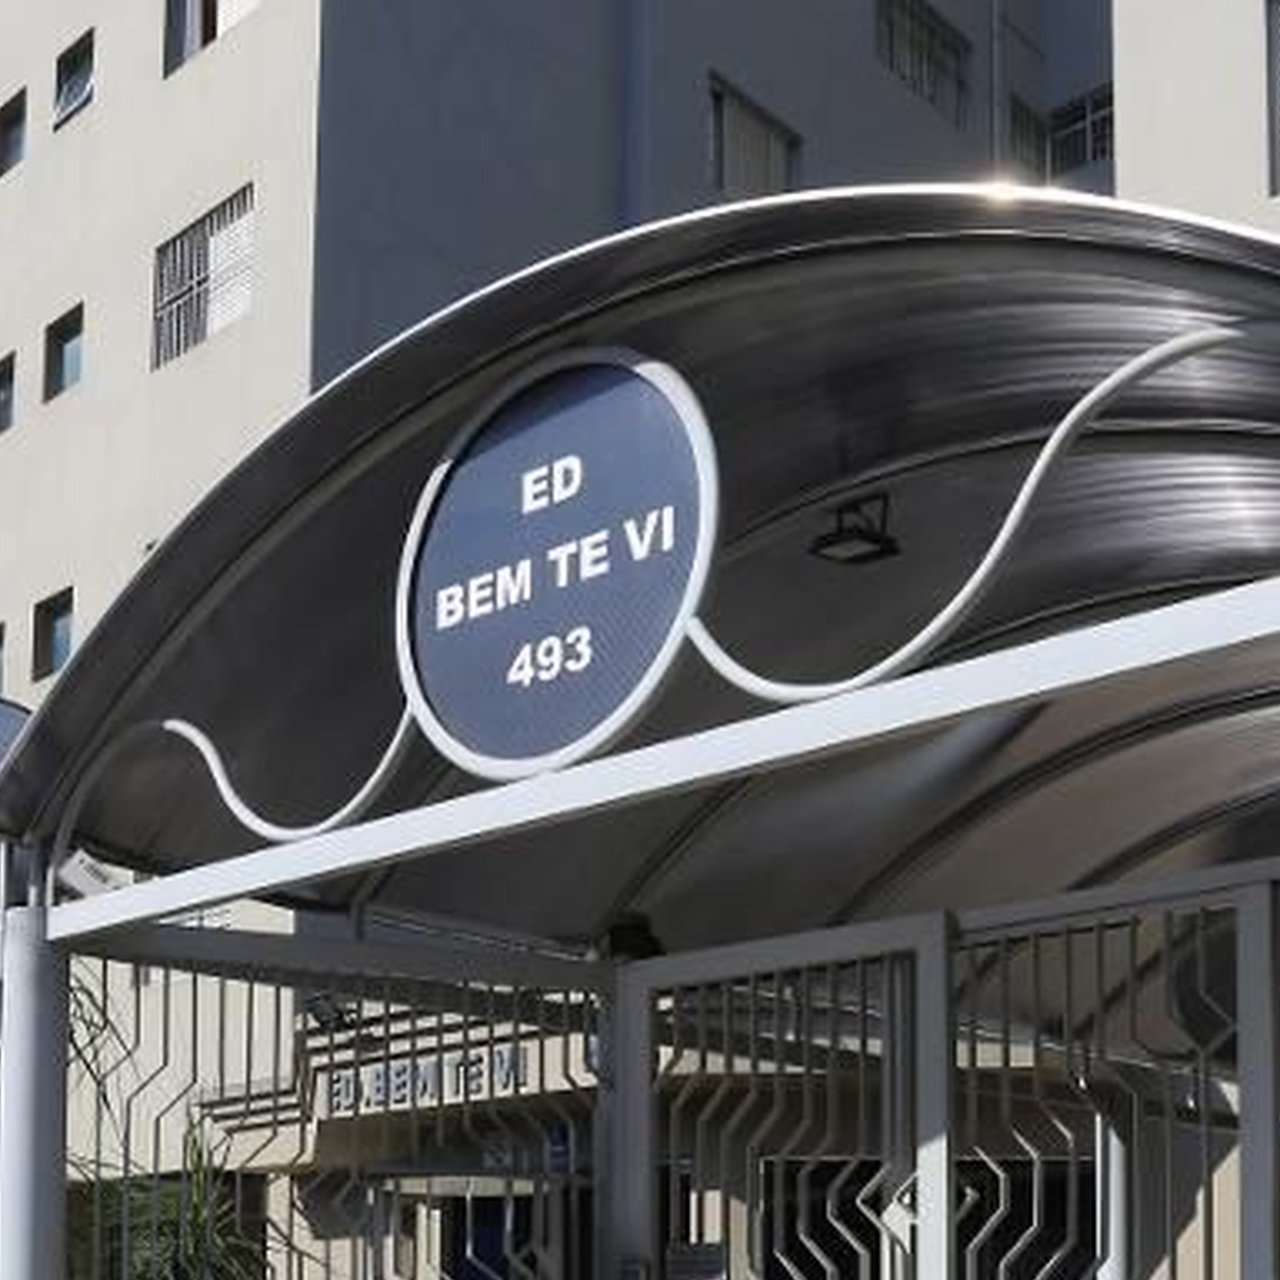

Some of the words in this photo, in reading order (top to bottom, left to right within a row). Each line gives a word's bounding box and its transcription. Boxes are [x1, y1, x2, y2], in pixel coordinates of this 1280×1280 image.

[521, 455, 583, 514] ED
[436, 560, 532, 629] BEM
[548, 531, 610, 588] TE
[624, 506, 676, 561] VI
[506, 626, 592, 687] 493
